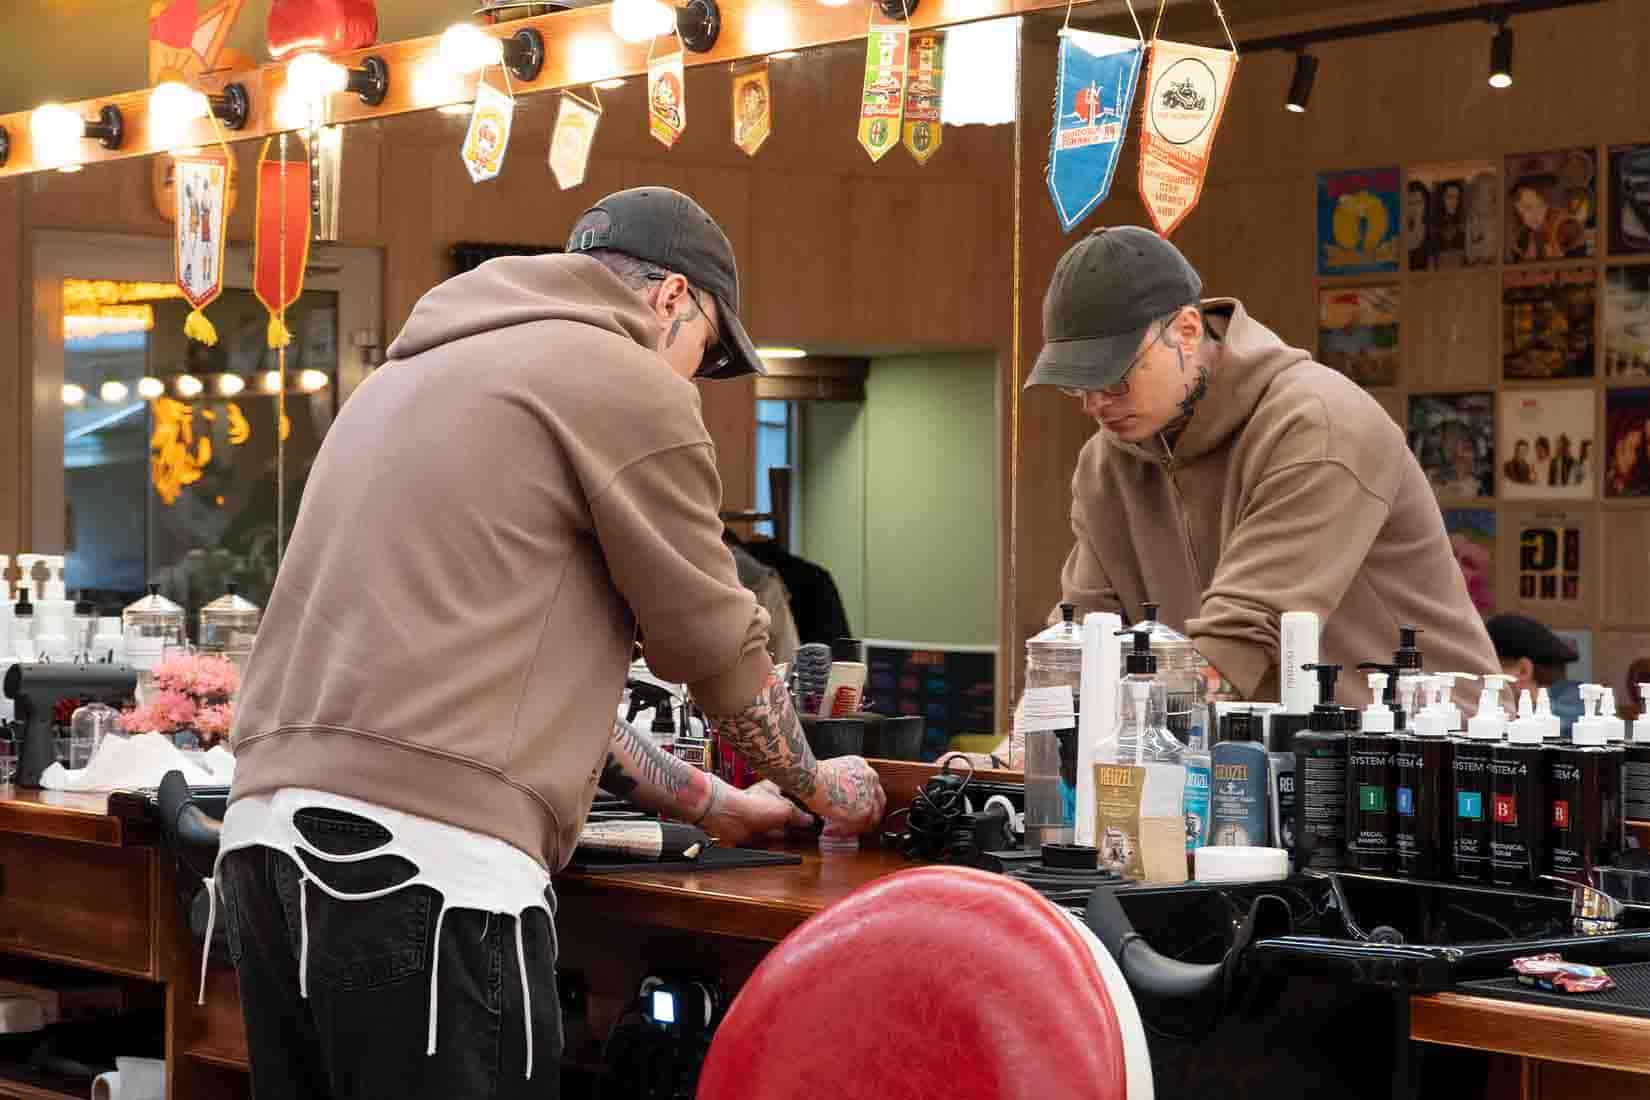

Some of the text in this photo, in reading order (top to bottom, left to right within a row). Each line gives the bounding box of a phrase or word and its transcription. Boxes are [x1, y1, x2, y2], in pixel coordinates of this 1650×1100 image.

[1350, 756, 1386, 766] SYSTEM
[1415, 757, 1424, 768] 4
[1518, 764, 1528, 776] 4
[1571, 768, 1580, 780] 4
[1498, 801, 1509, 817] B
